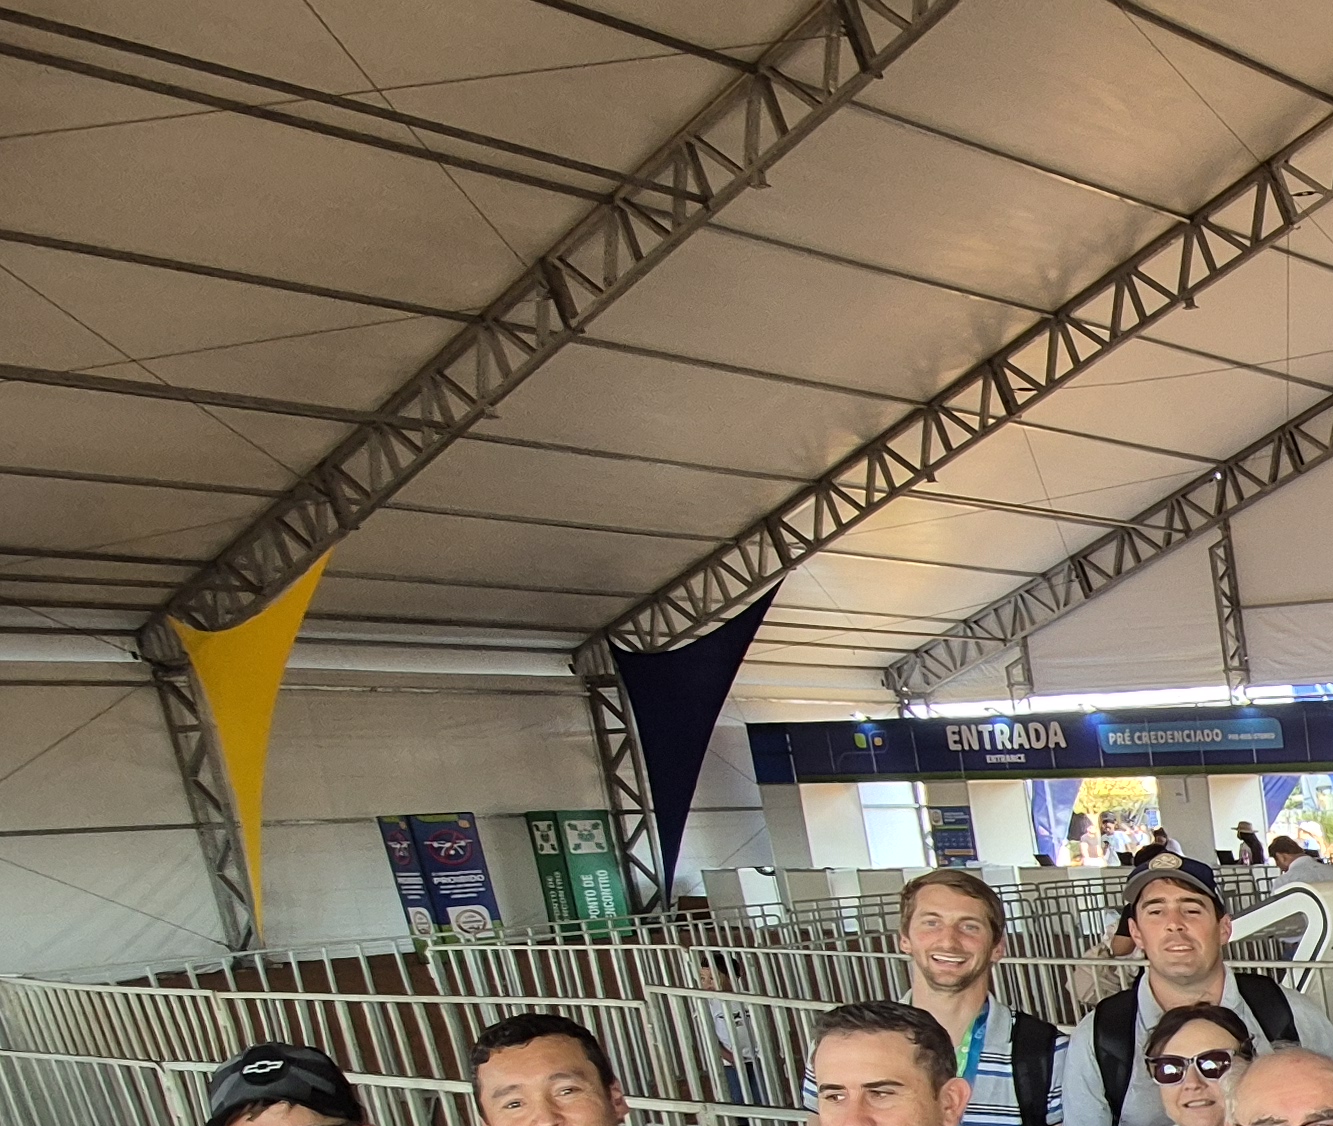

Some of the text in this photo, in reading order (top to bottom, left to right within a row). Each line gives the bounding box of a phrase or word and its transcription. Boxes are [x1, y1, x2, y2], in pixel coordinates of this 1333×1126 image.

[946, 721, 1067, 751] ENTRADA
[1109, 728, 1223, 745] PRÉ CREDENCIADO
[580, 874, 595, 888] DE
[596, 869, 617, 918] ENCONTRO
